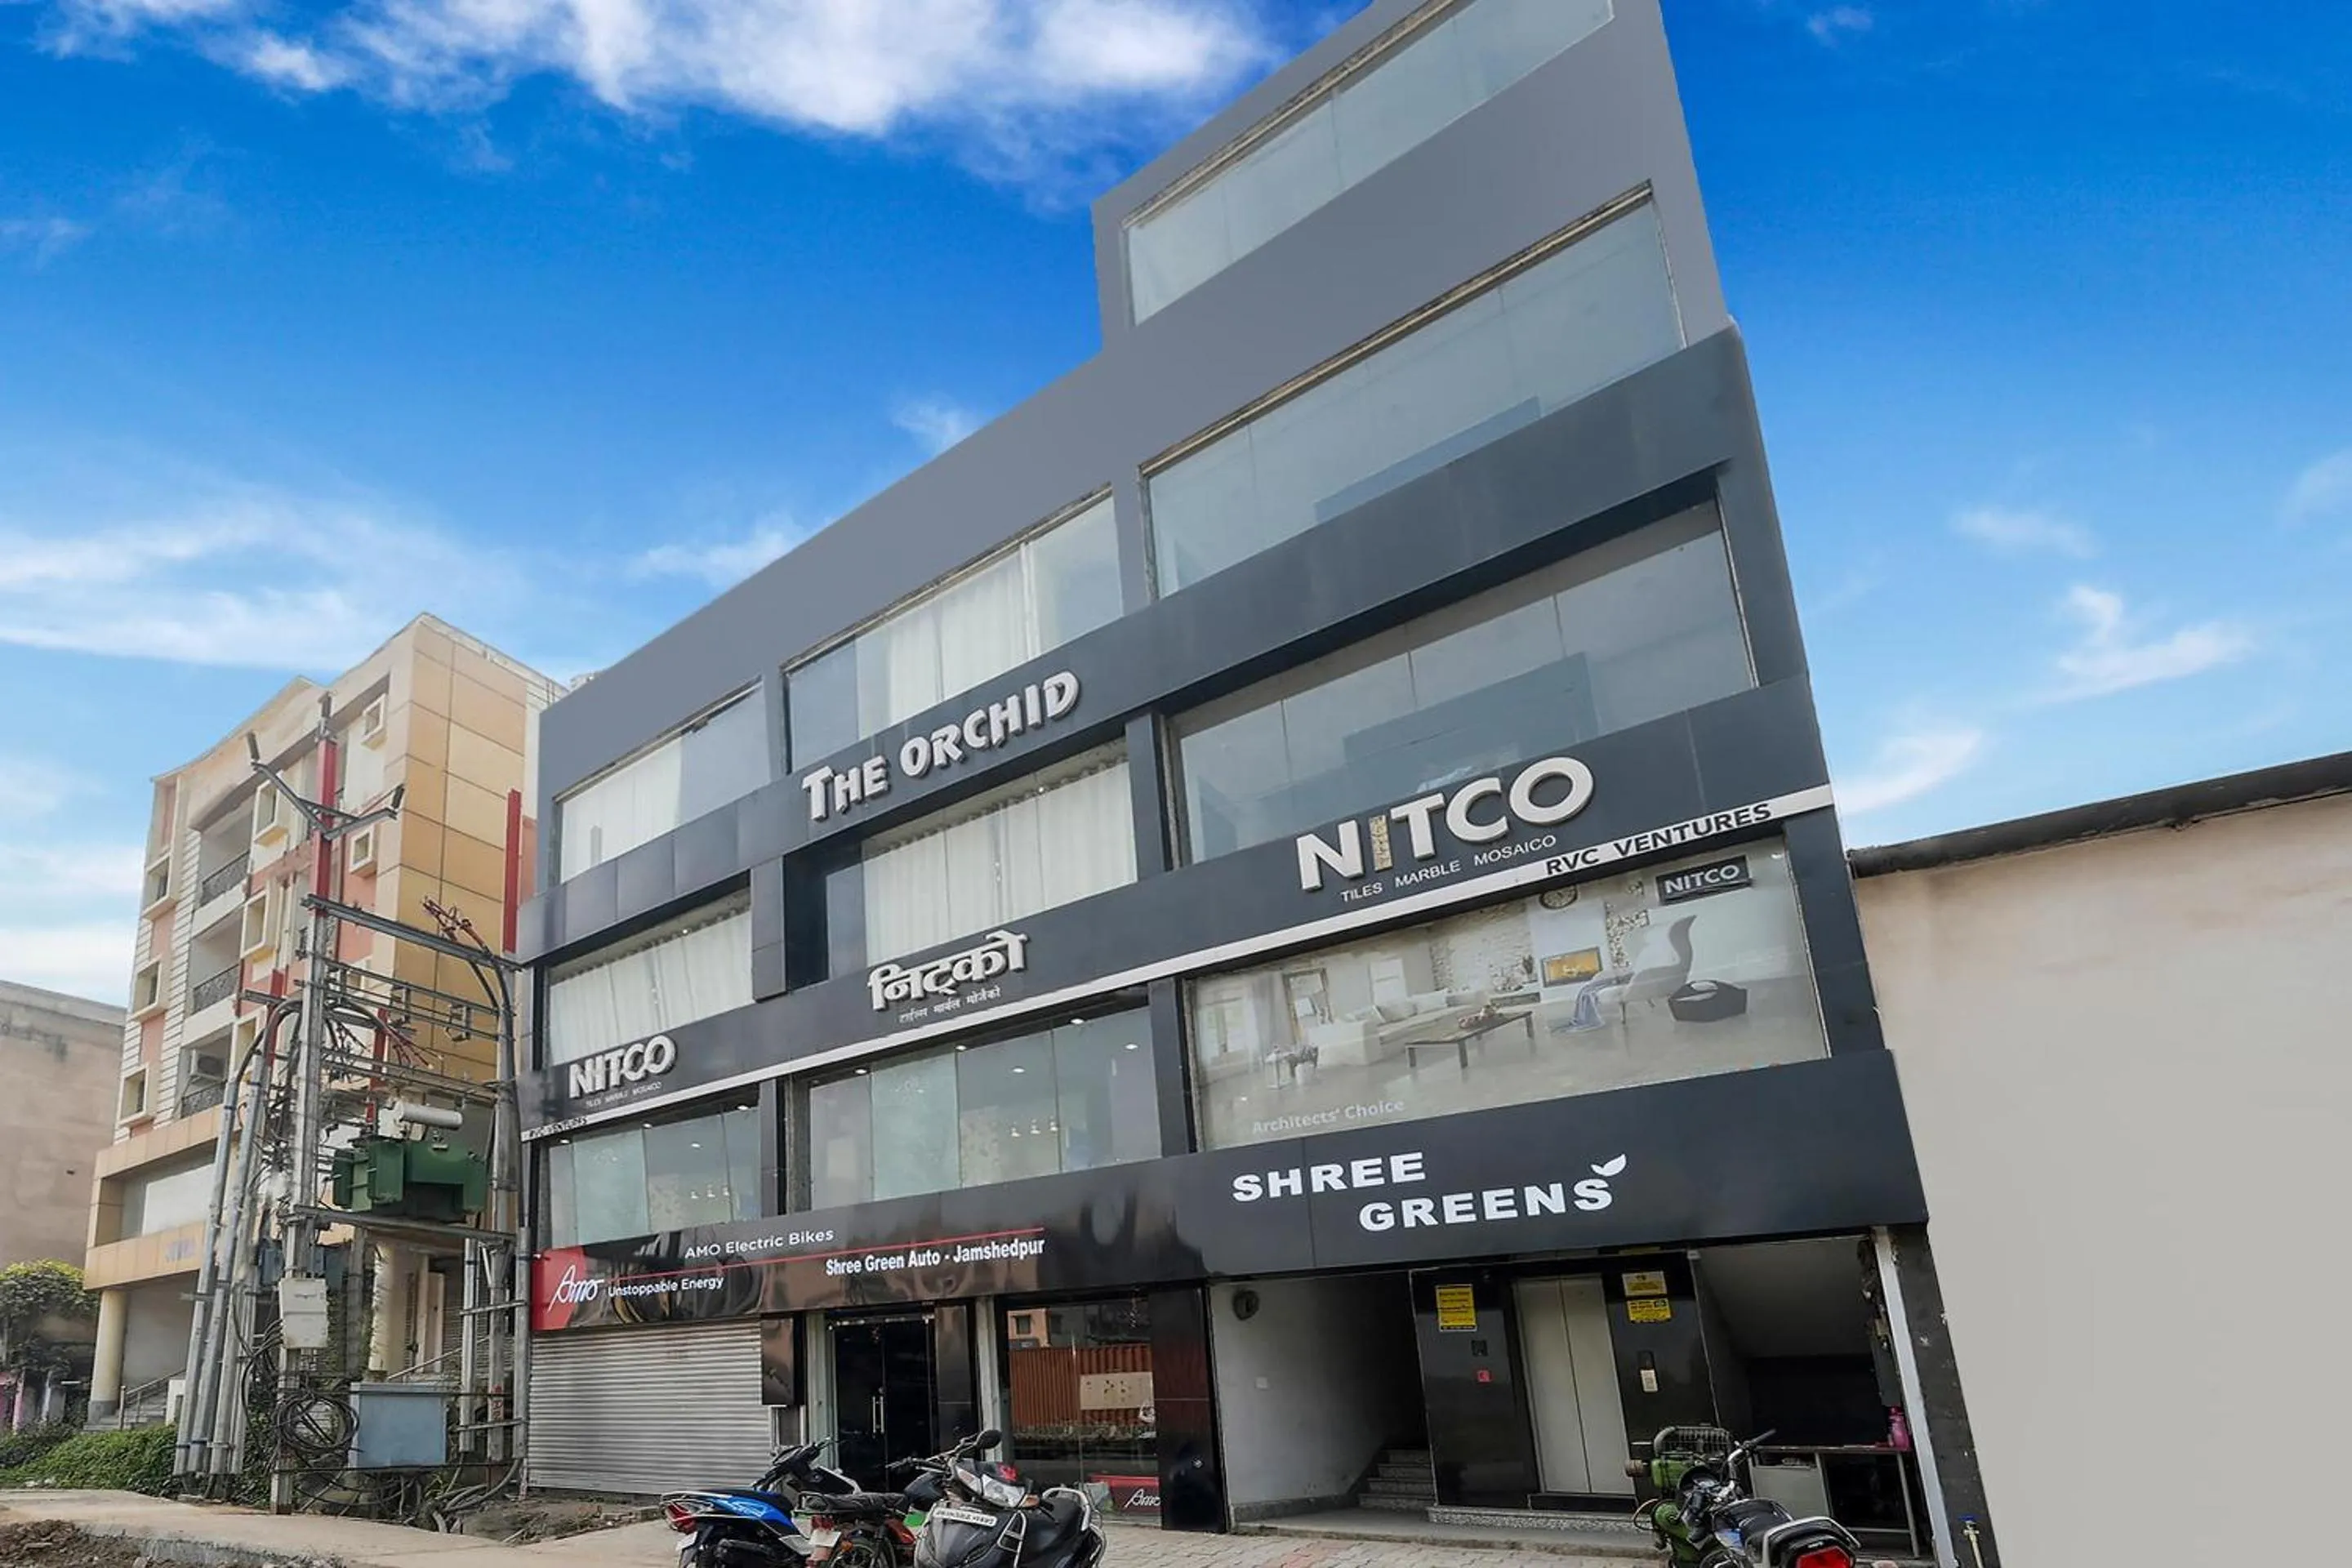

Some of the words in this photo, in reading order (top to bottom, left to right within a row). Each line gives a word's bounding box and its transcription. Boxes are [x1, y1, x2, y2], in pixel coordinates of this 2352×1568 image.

[802, 755, 889, 821] THE
[900, 670, 1080, 777] ORCHID
[1295, 756, 1594, 891] NITCO
[1546, 848, 1600, 875] RVC
[1614, 803, 1771, 857] VENTURES
[1340, 881, 1383, 902] TILES
[1395, 860, 1461, 889] MARBLE
[1474, 835, 1557, 866] MOSAICO
[1664, 864, 1740, 894] NITCO
[569, 1035, 677, 1099] NITCO
[1345, 1099, 1405, 1120] Choice
[1232, 1152, 1427, 1202] SHREE
[1359, 1178, 1613, 1232] GREENS
[684, 1244, 720, 1259] AMO
[726, 1234, 783, 1254] Electric
[789, 1229, 835, 1245] Bikes
[826, 1258, 862, 1276] Shree
[865, 1254, 906, 1271] Green
[908, 1250, 940, 1267] Auto
[953, 1237, 1045, 1263] Jamshedpur
[608, 1277, 679, 1298] Unstoppable
[682, 1276, 724, 1292] Energy
